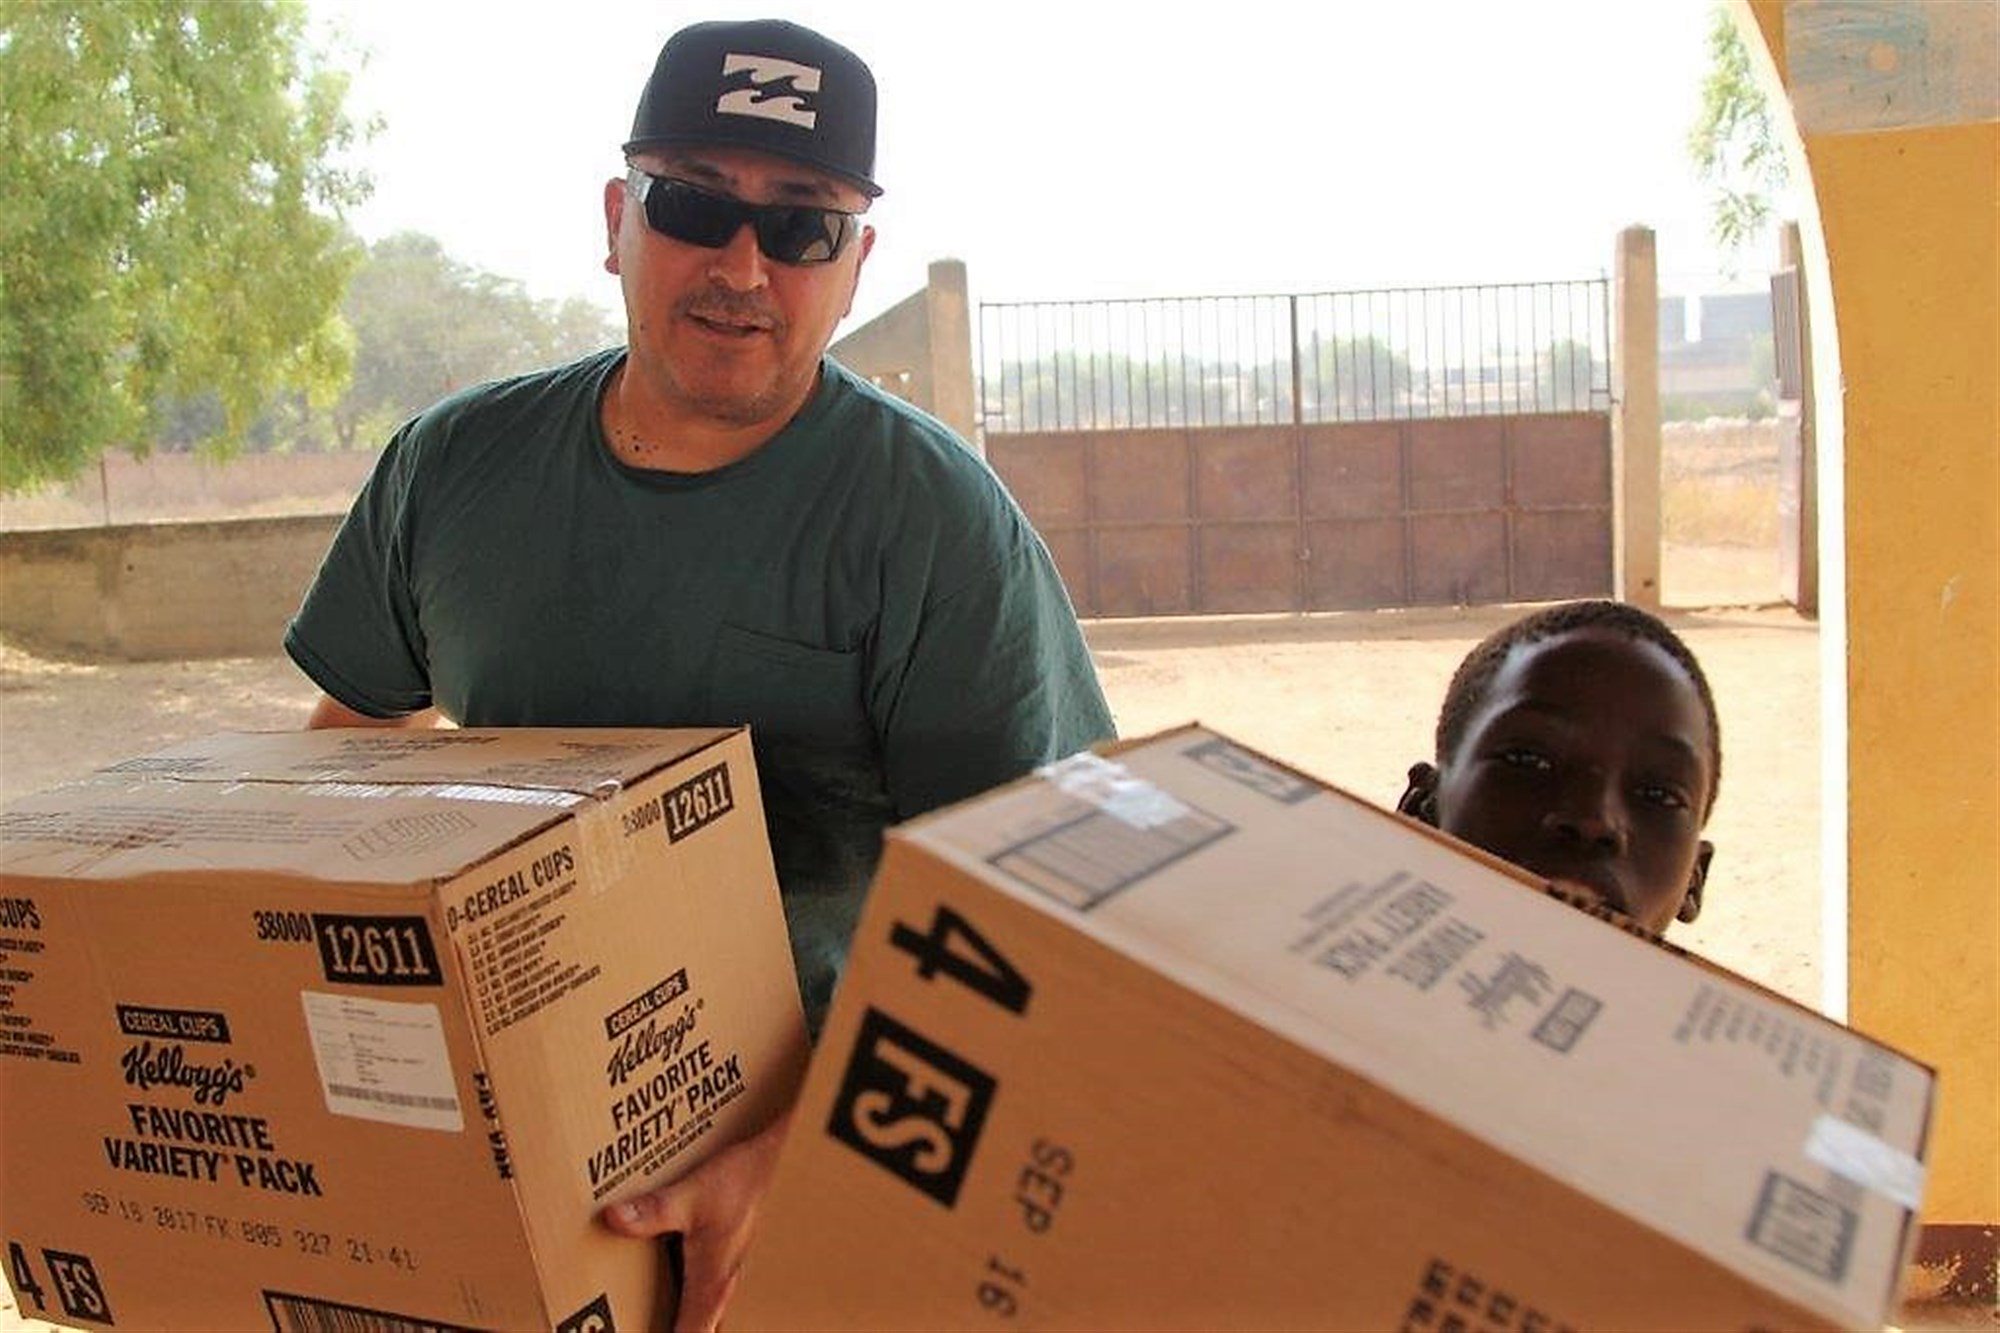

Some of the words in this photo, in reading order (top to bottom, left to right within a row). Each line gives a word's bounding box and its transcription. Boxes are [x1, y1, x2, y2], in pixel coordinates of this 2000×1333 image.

[668, 771, 731, 834] 12611
[531, 845, 576, 888] CUPS
[254, 910, 313, 943] 38000
[324, 924, 431, 975] 12611
[889, 903, 1034, 1017] 4
[123, 1010, 178, 1034] CEREAL
[179, 1016, 220, 1038] CUPS
[611, 1041, 714, 1132] FAVORITE
[851, 1036, 974, 1175] FS
[127, 1104, 274, 1152] FAVORITE
[587, 1099, 678, 1186] VARIETY
[686, 1053, 742, 1114] PACK
[104, 1136, 218, 1183] VARIETY
[234, 1154, 323, 1197] PACK
[1013, 1136, 1075, 1234] SEP
[294, 1229, 331, 1256] 327
[9, 1241, 45, 1311] 4
[52, 1259, 102, 1315] FS
[976, 1254, 1027, 1318] 16
